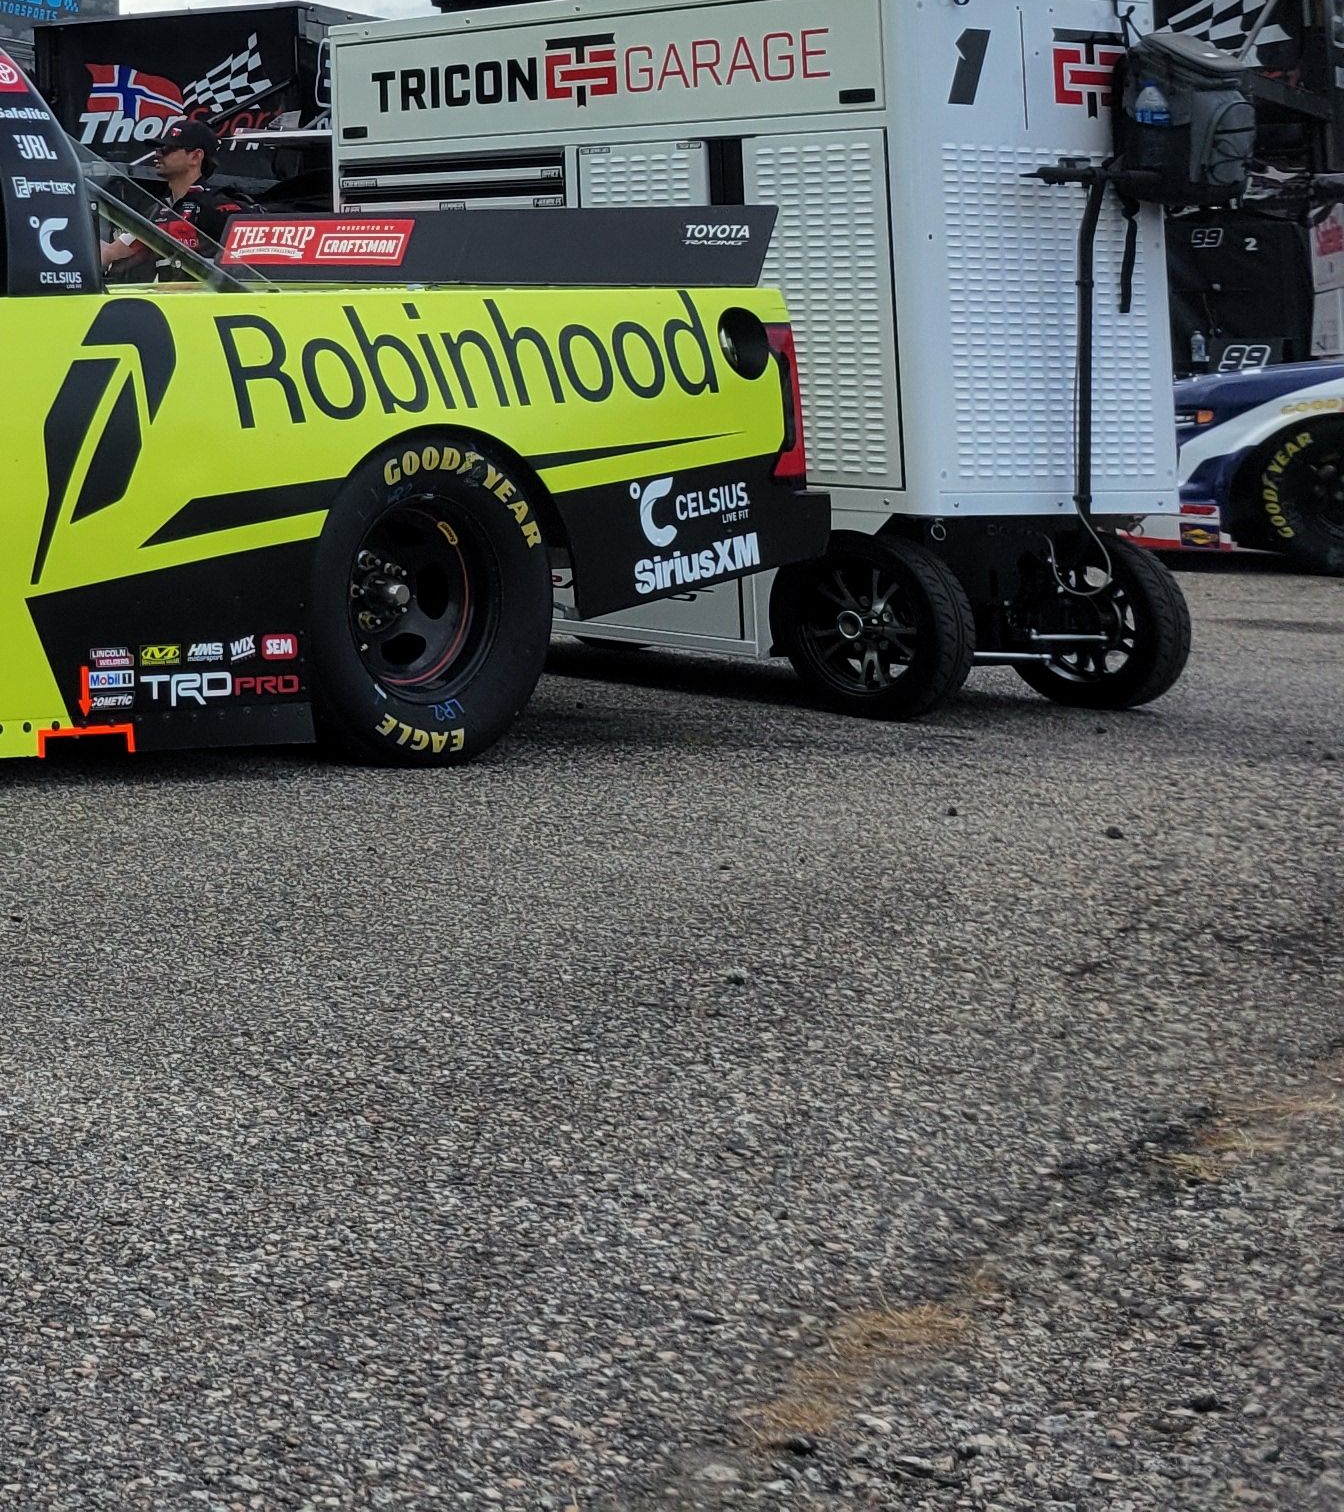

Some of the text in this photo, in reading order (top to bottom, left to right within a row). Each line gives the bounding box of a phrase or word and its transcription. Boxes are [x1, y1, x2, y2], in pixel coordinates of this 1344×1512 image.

[372, 27, 831, 114] TRICON GARAGE
[948, 28, 991, 105] 1
[13, 135, 58, 160] JBL
[231, 226, 316, 249] THE TRIP
[685, 224, 750, 239] TOYOTA
[1191, 228, 1224, 248] 99
[323, 239, 396, 254] CRAFTSMAN
[1243, 237, 1259, 252] 2
[40, 272, 82, 284] CELSIUS
[213, 290, 720, 429] Robinhood
[1218, 344, 1271, 372] 99
[1262, 431, 1313, 538] GOODYEAR
[383, 447, 543, 548] GOODYEAR
[675, 482, 750, 521] CELSIUS
[721, 509, 750, 523] LIVE FIT
[634, 532, 760, 595] SiriusXM
[92, 648, 126, 658] LINCOLN
[188, 642, 223, 656] HMS
[230, 635, 256, 656] WIX
[266, 638, 293, 655] SEM
[99, 658, 130, 666] WELDERS
[187, 654, 223, 663] motorsport
[90, 672, 132, 687] Mobil 1
[140, 671, 299, 707] TRD PRO
[92, 694, 133, 708] COMETIC
[375, 713, 465, 753] EAGLE
